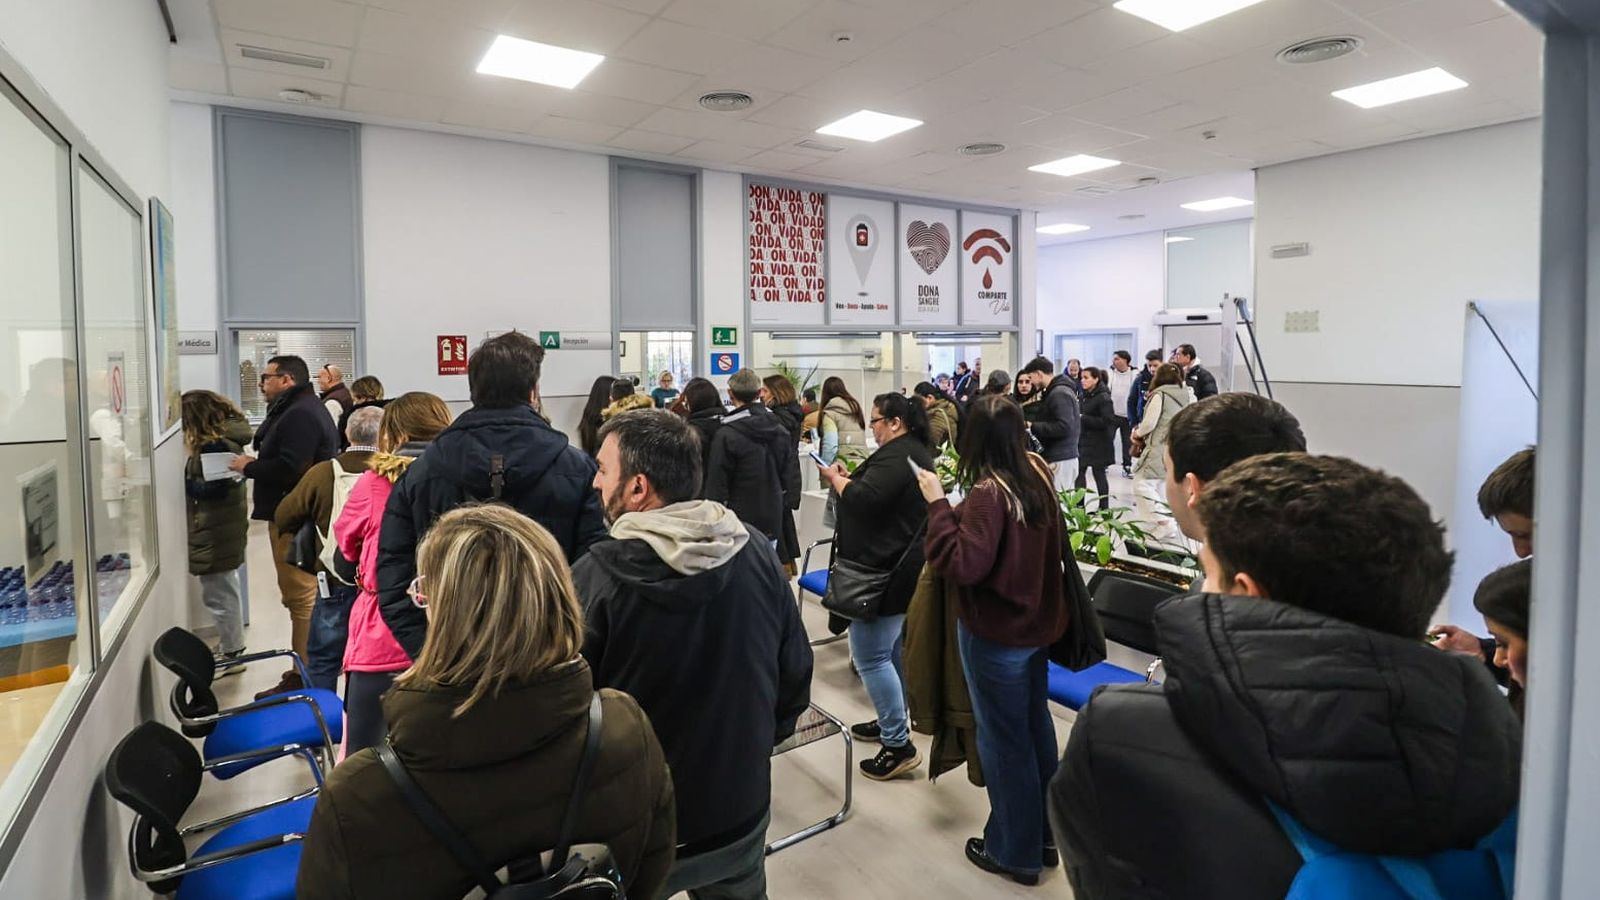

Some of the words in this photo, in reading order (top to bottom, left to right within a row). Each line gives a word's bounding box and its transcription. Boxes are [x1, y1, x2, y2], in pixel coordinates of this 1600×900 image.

[918, 285, 939, 296] DONA
[918, 297, 939, 306] SANGRE
[185, 338, 211, 347] Médico
